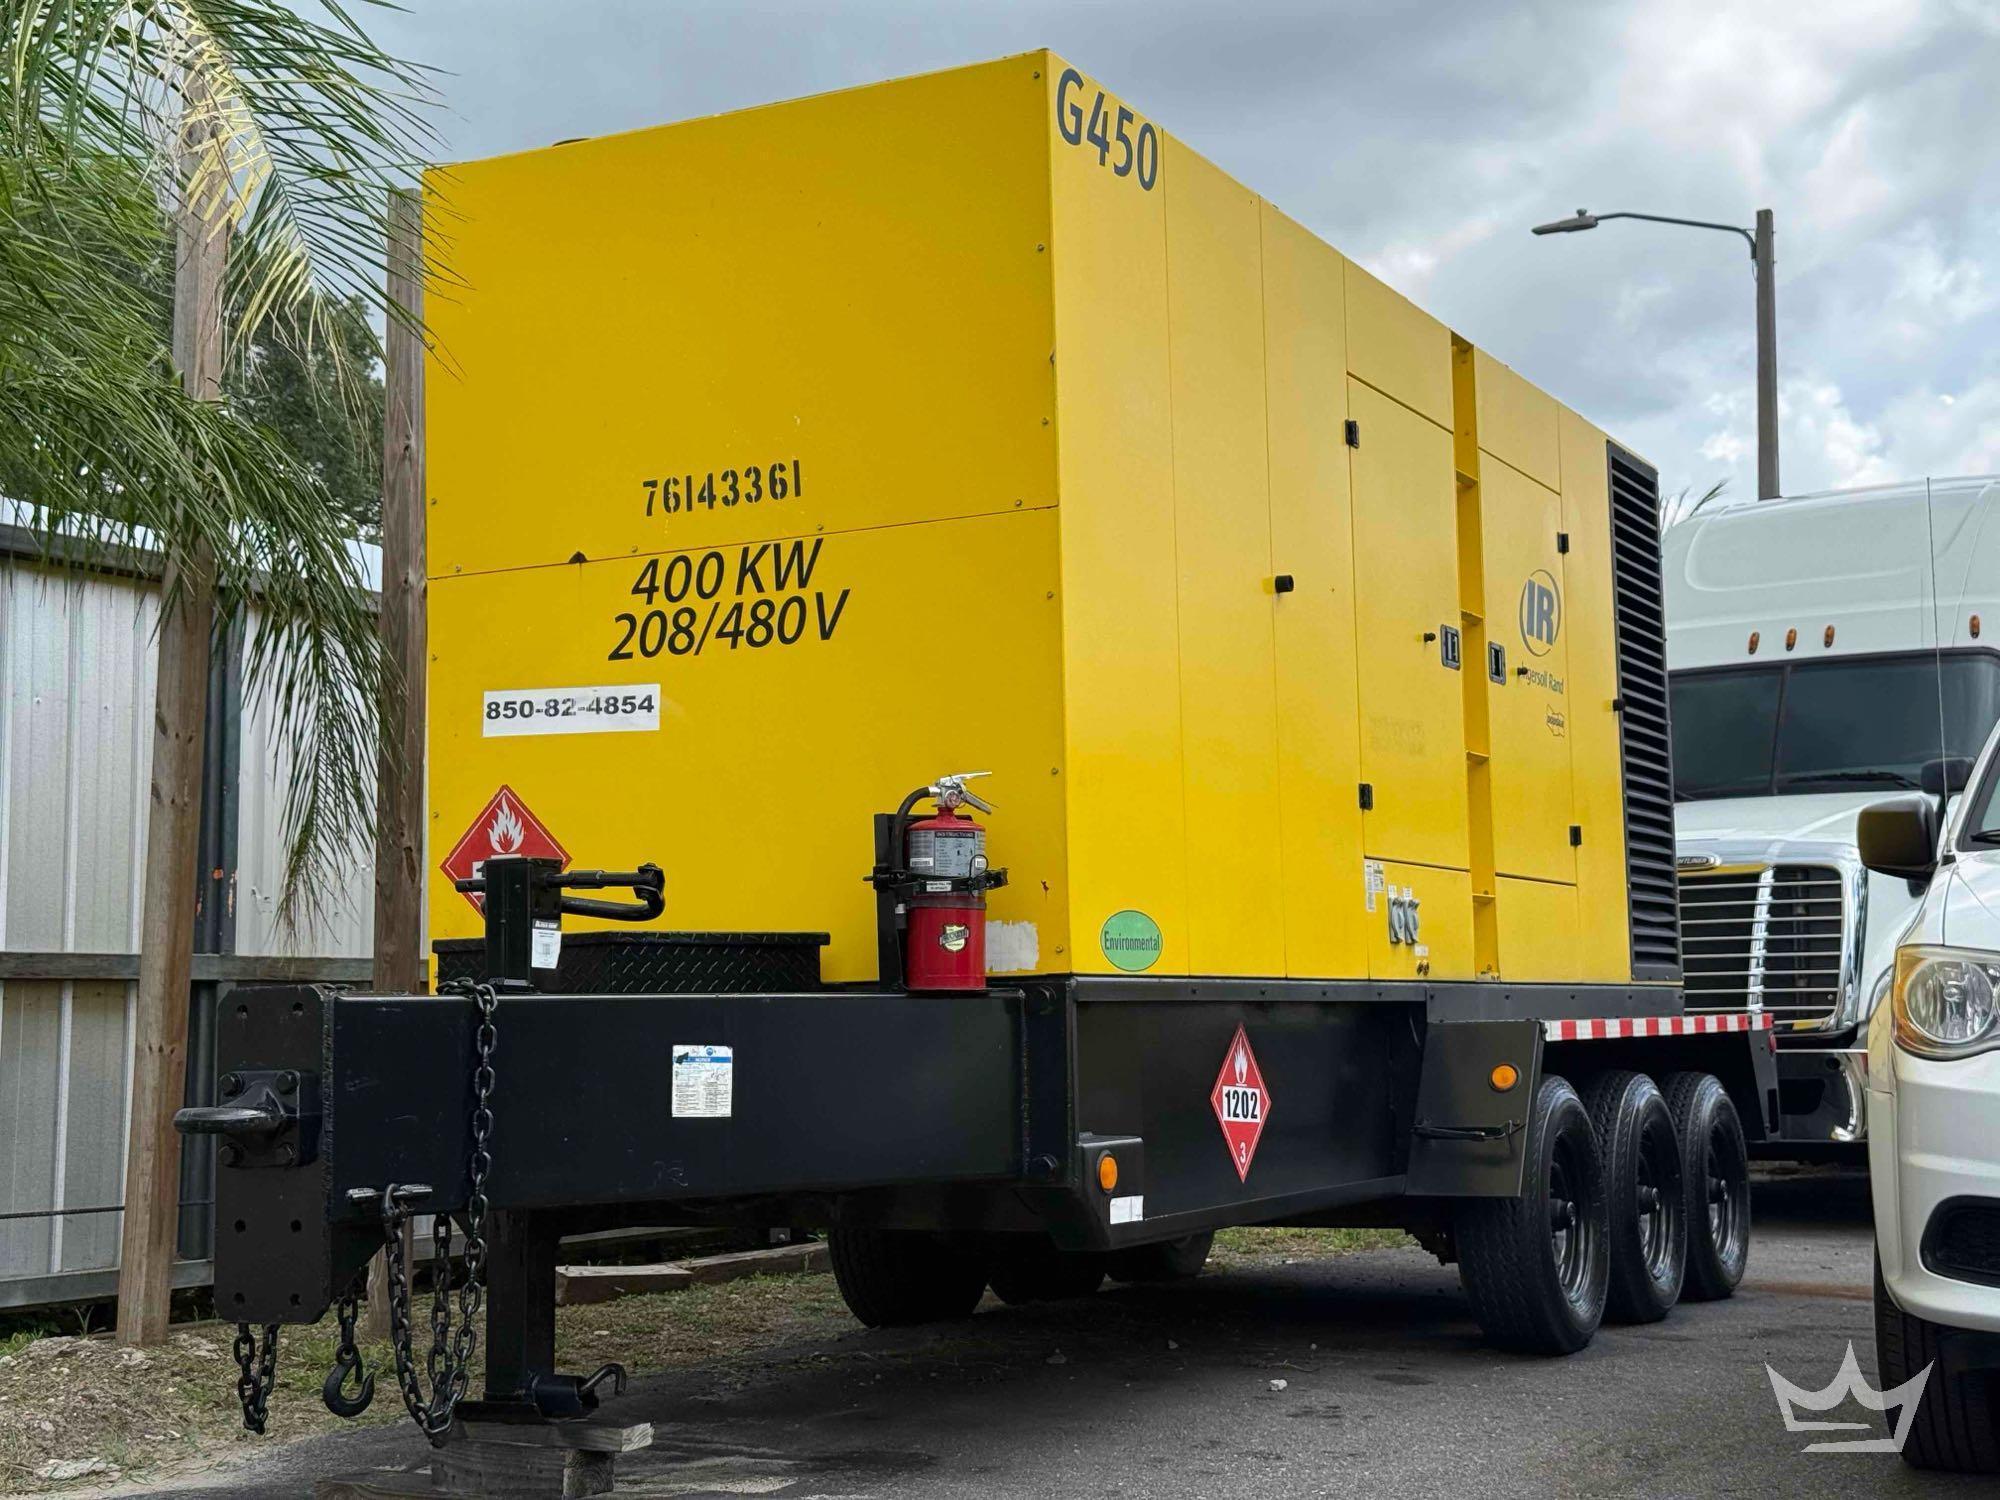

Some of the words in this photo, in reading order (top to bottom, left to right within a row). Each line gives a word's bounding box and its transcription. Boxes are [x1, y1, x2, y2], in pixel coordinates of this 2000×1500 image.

[1057, 68, 1158, 191] G450
[643, 460, 802, 517] 76143361
[631, 550, 725, 605] 400
[735, 538, 824, 596] KW
[1526, 576, 1554, 646] IR
[1548, 672, 1564, 695] Rand
[486, 694, 655, 721] 850-82-4854
[1104, 930, 1160, 951] Environmental
[1225, 1089, 1258, 1119] 1202
[1240, 1141, 1247, 1164] 3
